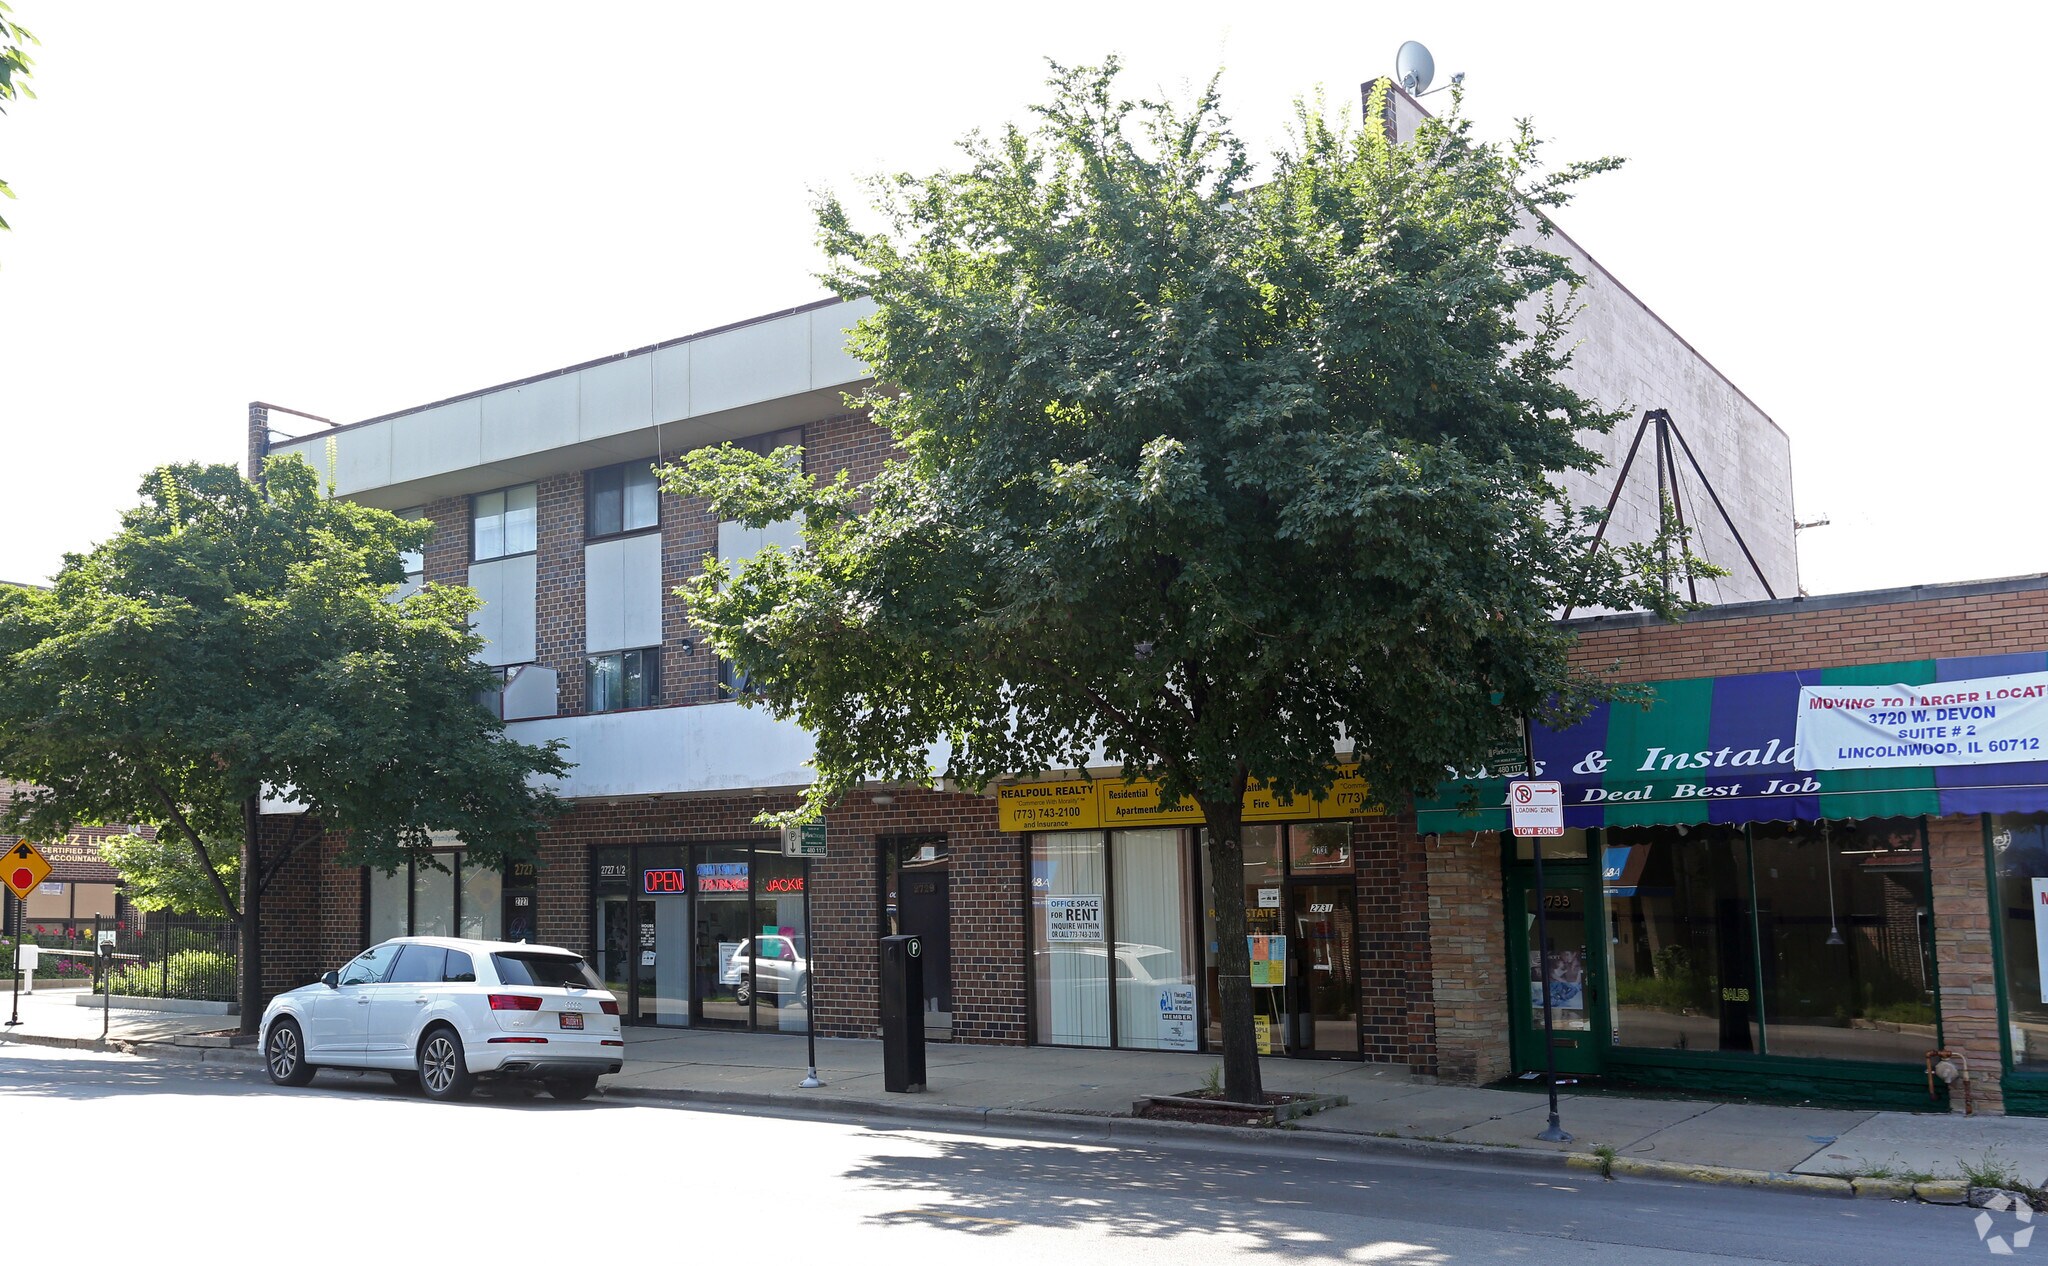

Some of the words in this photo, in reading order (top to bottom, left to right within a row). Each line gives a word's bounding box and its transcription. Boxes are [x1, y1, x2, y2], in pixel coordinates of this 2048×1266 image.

[1809, 697, 1875, 710] MOVING
[1881, 698, 1904, 707] TO
[1986, 685, 2048, 700] LOCAT
[1868, 711, 1907, 725] 3720
[1912, 710, 1930, 723] W.
[1936, 706, 1996, 721] DEVON
[1898, 727, 1947, 739] SUITE
[1952, 726, 1961, 737] #
[1966, 725, 1976, 736] 2
[1838, 743, 1962, 760] LINCOLNWOOD,
[1968, 742, 1983, 754] IL
[1989, 738, 2040, 753] 60712
[1498, 765, 1510, 773] 480
[1511, 764, 1522, 772] 117
[1572, 750, 1613, 774] &
[1001, 788, 1053, 799] REALPOUL
[1055, 785, 1094, 796] REALTY
[1108, 788, 1149, 800] Residential
[1581, 785, 1652, 803] Deal
[1671, 783, 1743, 799] Best
[1761, 777, 1822, 795] Job
[1253, 799, 1270, 809] Fire
[1336, 792, 1365, 806] (773)
[1013, 809, 1036, 821] (773)
[1039, 807, 1081, 818] 743-2100
[1115, 804, 1159, 817] Apartment
[1037, 820, 1069, 828] Insurance
[1517, 827, 1534, 836] TOW
[1537, 827, 1559, 836] ZONE
[41, 846, 83, 855] CERTIFIED
[514, 863, 534, 876] 2727
[600, 865, 614, 875] 2727
[616, 865, 626, 875] 1/2
[645, 871, 683, 891] OPEN
[1050, 900, 1075, 908] OFFICE
[1076, 900, 1099, 908] SPACE
[1311, 903, 1332, 912] 2731
[1546, 895, 1570, 908] 733
[1065, 908, 1099, 921] RENT
[1051, 922, 1076, 931] INQUIRE
[1076, 922, 1100, 930] WITHIN
[1051, 930, 1058, 938] OR
[1058, 930, 1069, 938] CALL
[1069, 930, 1100, 938] 773-743-2100
[1722, 987, 1749, 1001] SALES
